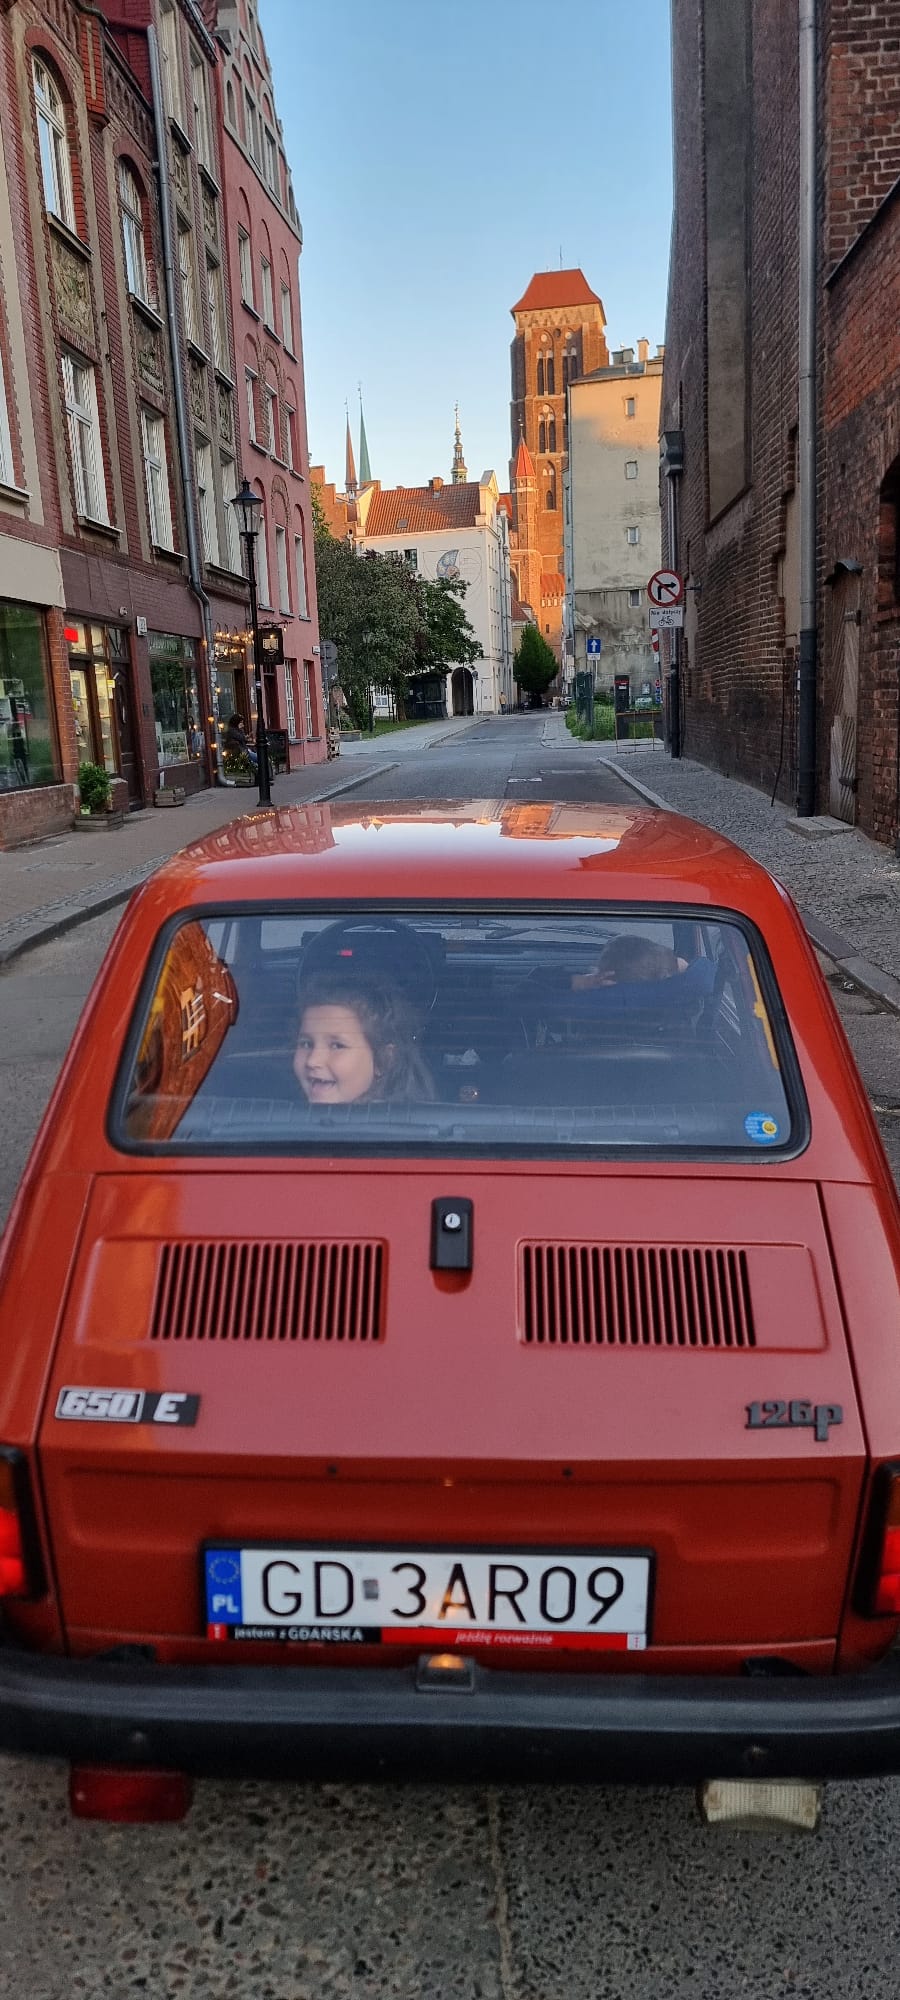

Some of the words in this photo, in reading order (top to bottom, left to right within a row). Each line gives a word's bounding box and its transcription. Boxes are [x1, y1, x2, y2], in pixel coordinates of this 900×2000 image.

[61, 1391, 136, 1417] 650
[153, 1392, 187, 1422] E
[745, 1400, 843, 1442] 126p
[212, 1594, 239, 1613] PL
[261, 1560, 354, 1618] GD
[391, 1562, 624, 1625] 3AR09
[234, 1627, 275, 1640] jestem
